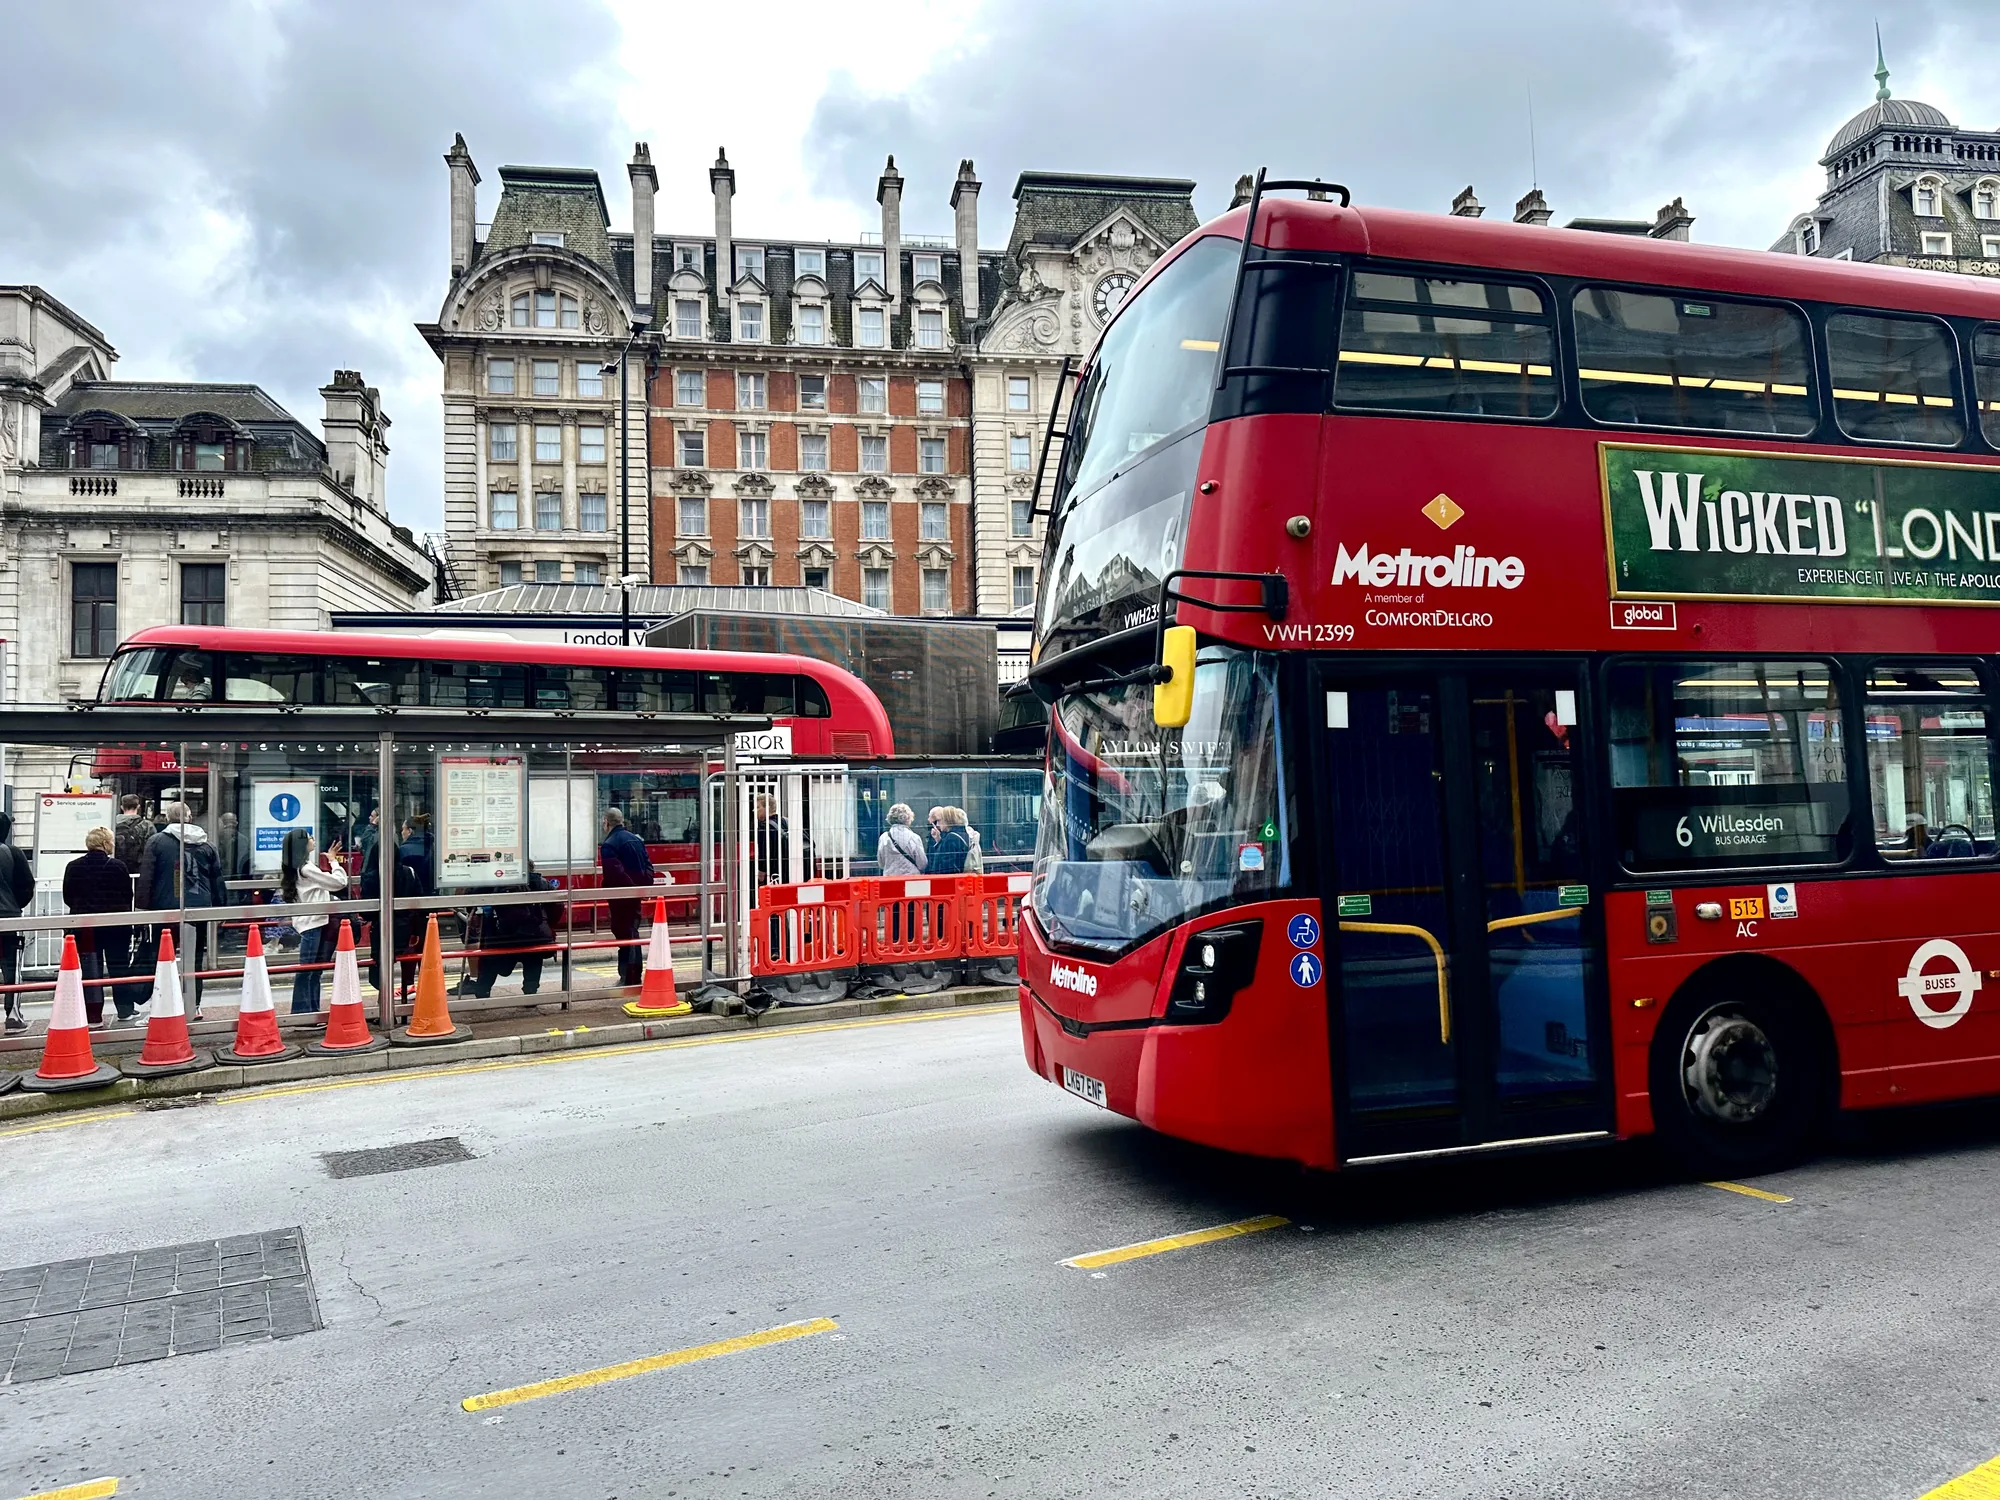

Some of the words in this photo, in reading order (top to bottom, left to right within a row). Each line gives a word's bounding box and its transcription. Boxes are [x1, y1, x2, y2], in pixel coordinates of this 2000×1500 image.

[1633, 469, 1846, 557] WICKED
[1331, 542, 1526, 590] Metroline
[1798, 568, 1872, 585] EXPERIENCE
[1875, 571, 1884, 585] IT
[1915, 572, 1928, 586] AT
[1934, 572, 1956, 587] THE
[1364, 593, 1372, 603] A
[1374, 593, 1413, 603] member
[1415, 593, 1425, 603] of
[1624, 605, 1663, 625] global
[1264, 824, 1274, 837] 6
[1676, 816, 1693, 848] 6
[1699, 813, 1783, 833] Willesden
[1715, 835, 1731, 846] BUS
[1733, 834, 1767, 845] GARAGE
[1734, 900, 1758, 917] 513
[1736, 921, 1758, 938] AC
[1050, 959, 1097, 997] Metroline
[1925, 978, 1956, 990] BUSES
[1065, 1068, 1085, 1094] LK67
[1087, 1079, 1103, 1101] ENF
